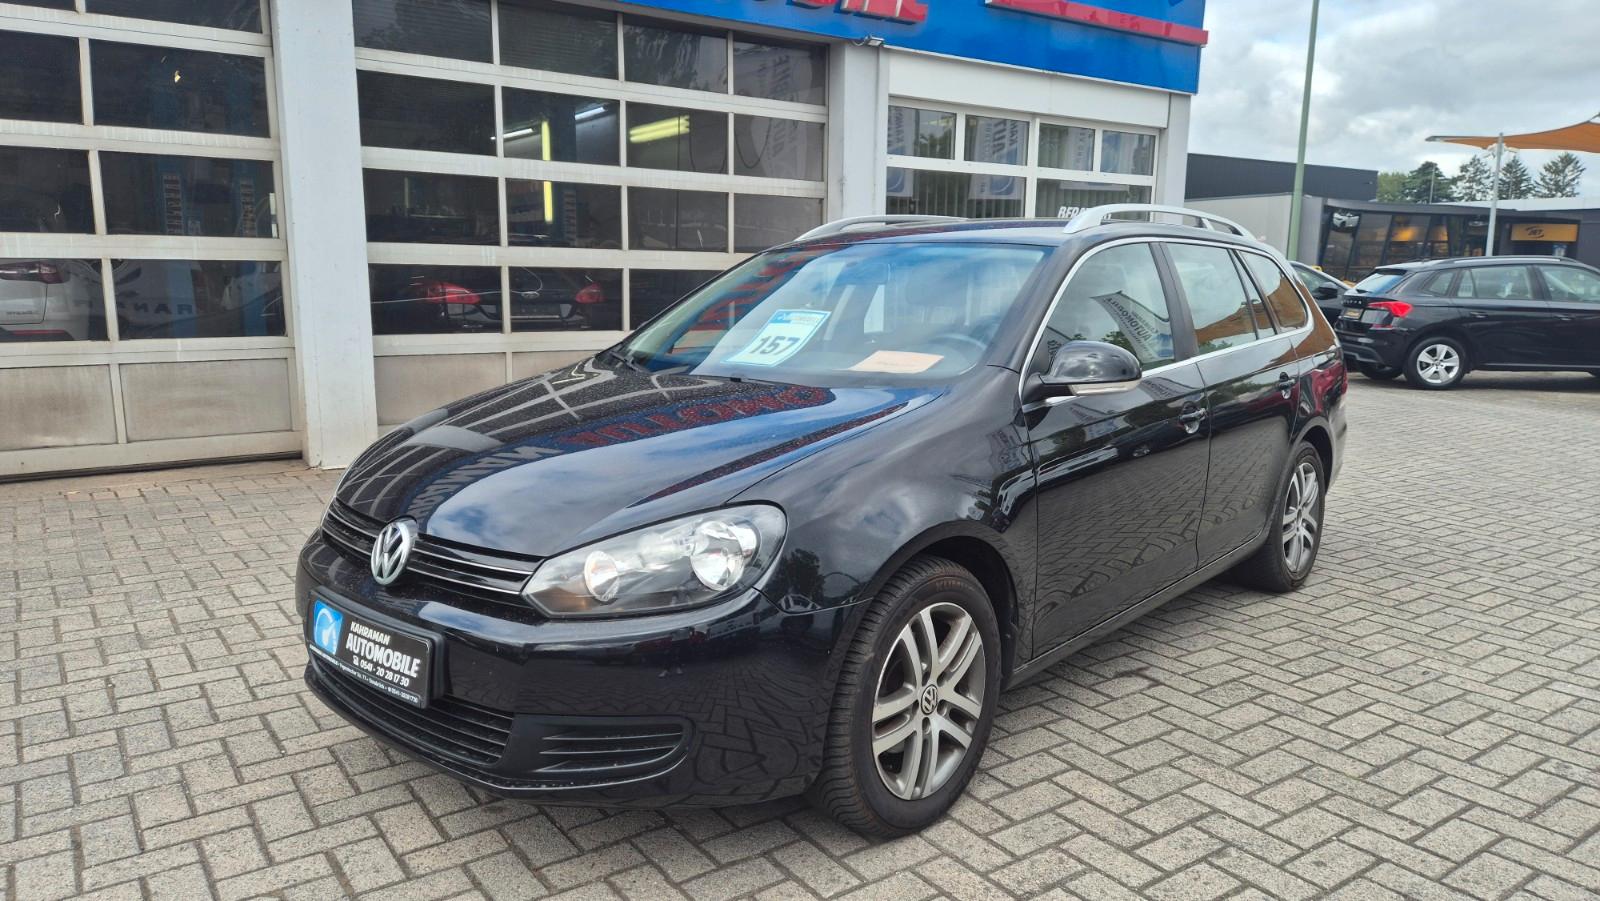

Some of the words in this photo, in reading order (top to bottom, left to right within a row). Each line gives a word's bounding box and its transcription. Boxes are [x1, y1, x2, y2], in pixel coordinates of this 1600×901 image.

[750, 335, 800, 355] 157
[350, 621, 391, 646] KAHRAMAN
[346, 633, 421, 677] AUTOMOBILE
[360, 659, 374, 672] 0541
[376, 666, 385, 677] 20
[385, 670, 394, 681] 28
[393, 673, 401, 683] 17
[400, 676, 410, 687] 30
